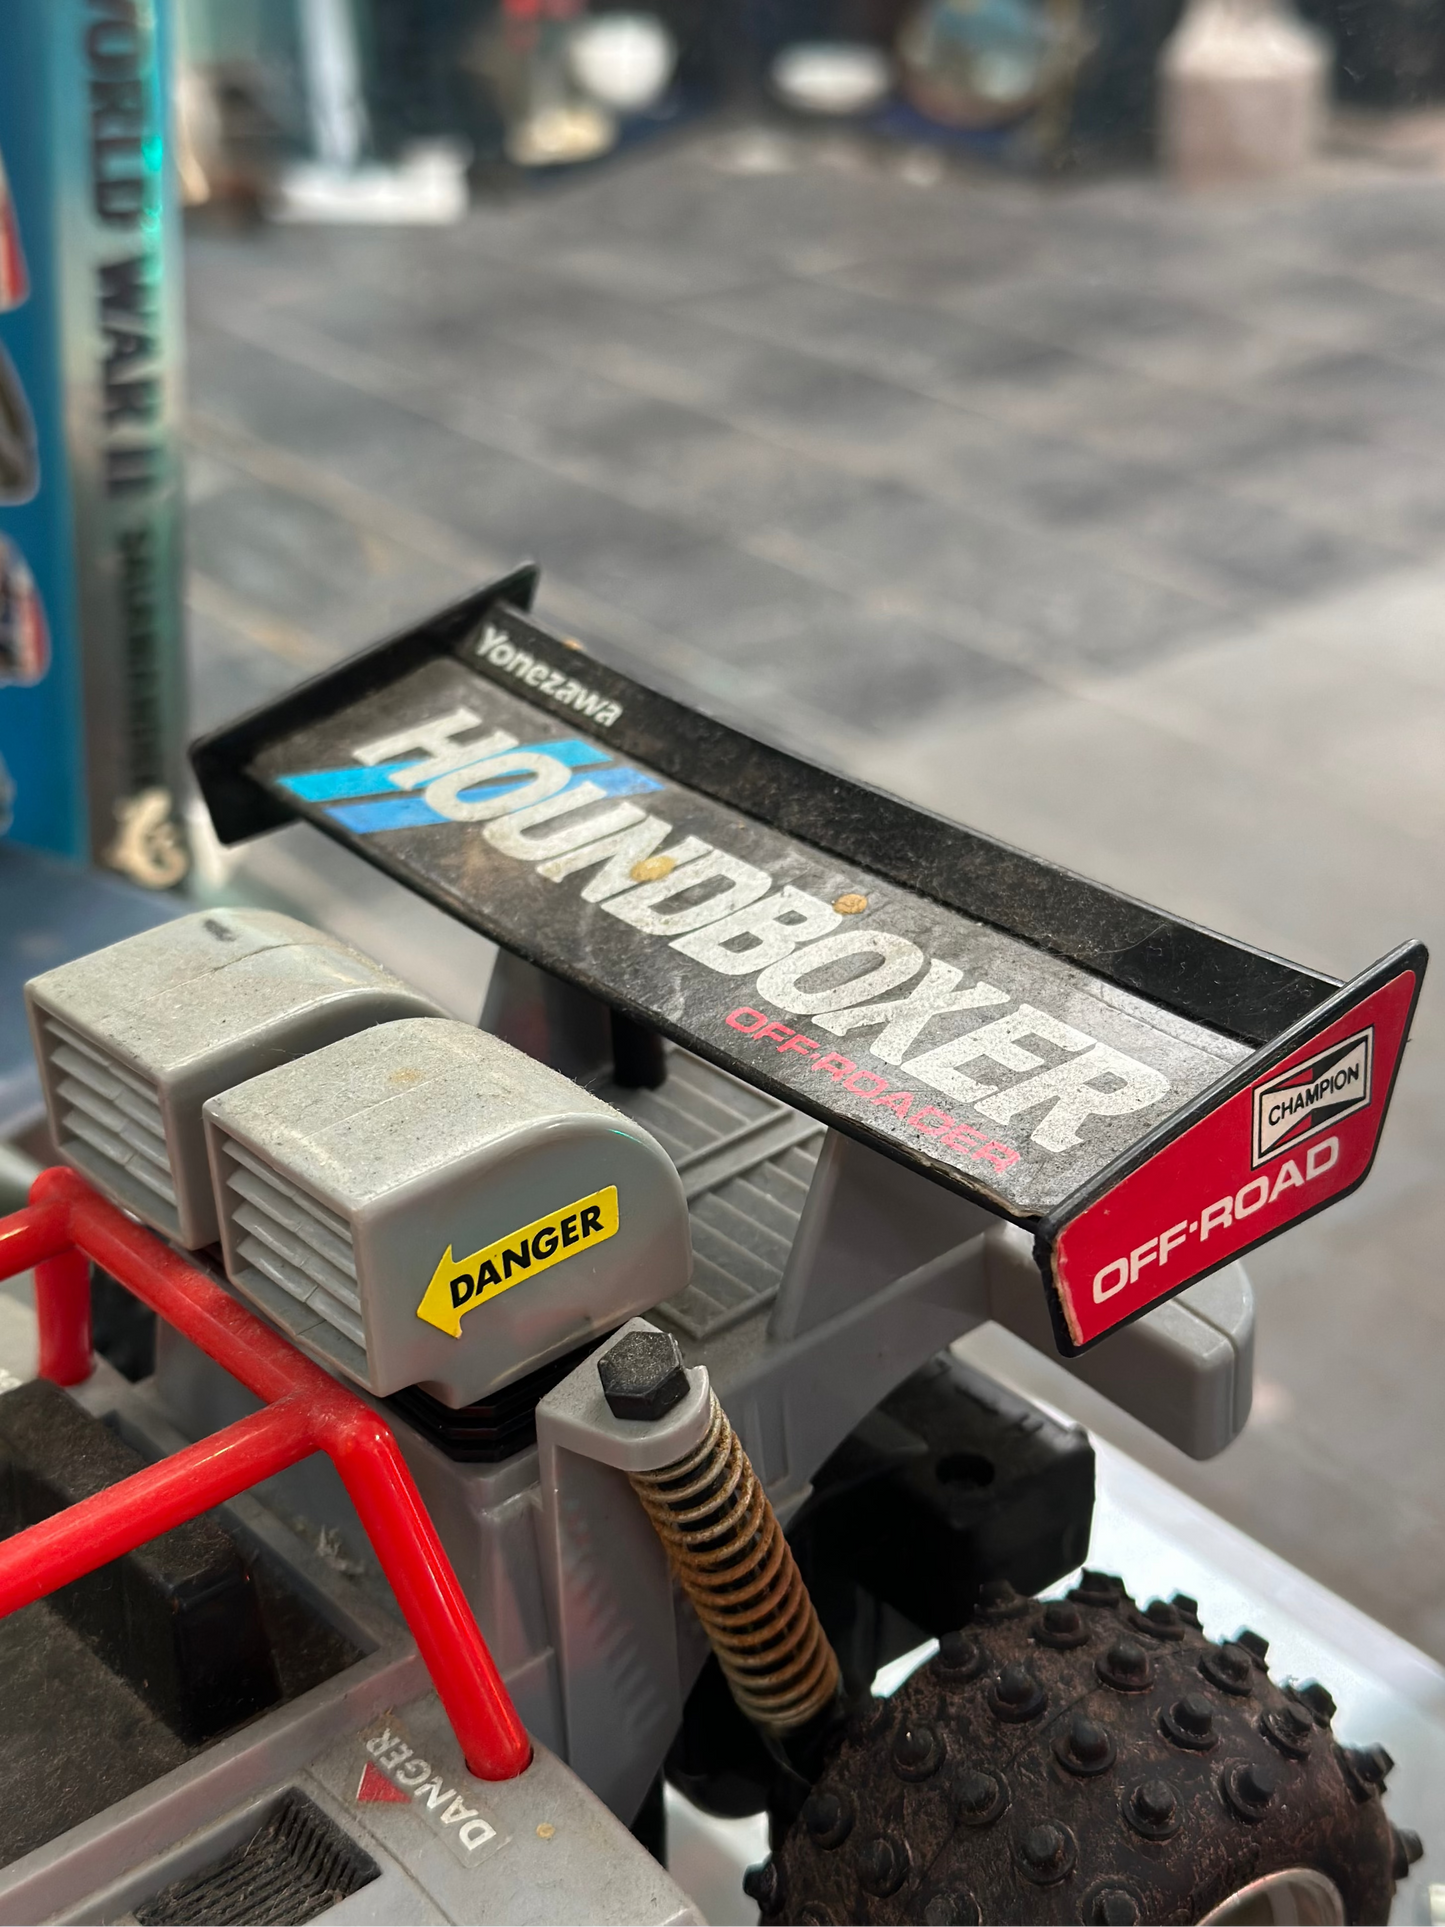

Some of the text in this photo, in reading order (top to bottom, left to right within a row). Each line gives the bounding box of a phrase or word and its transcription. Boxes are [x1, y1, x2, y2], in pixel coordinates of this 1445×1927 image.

[86, 0, 146, 231] ORLD
[97, 255, 159, 427] WAR
[476, 624, 623, 727] Yonezawa
[351, 707, 1170, 1153] HOUNDBOXER
[1267, 1062, 1361, 1127] CHAMPION
[450, 1205, 604, 1309] DANGER
[366, 1728, 497, 1851] DANGER
